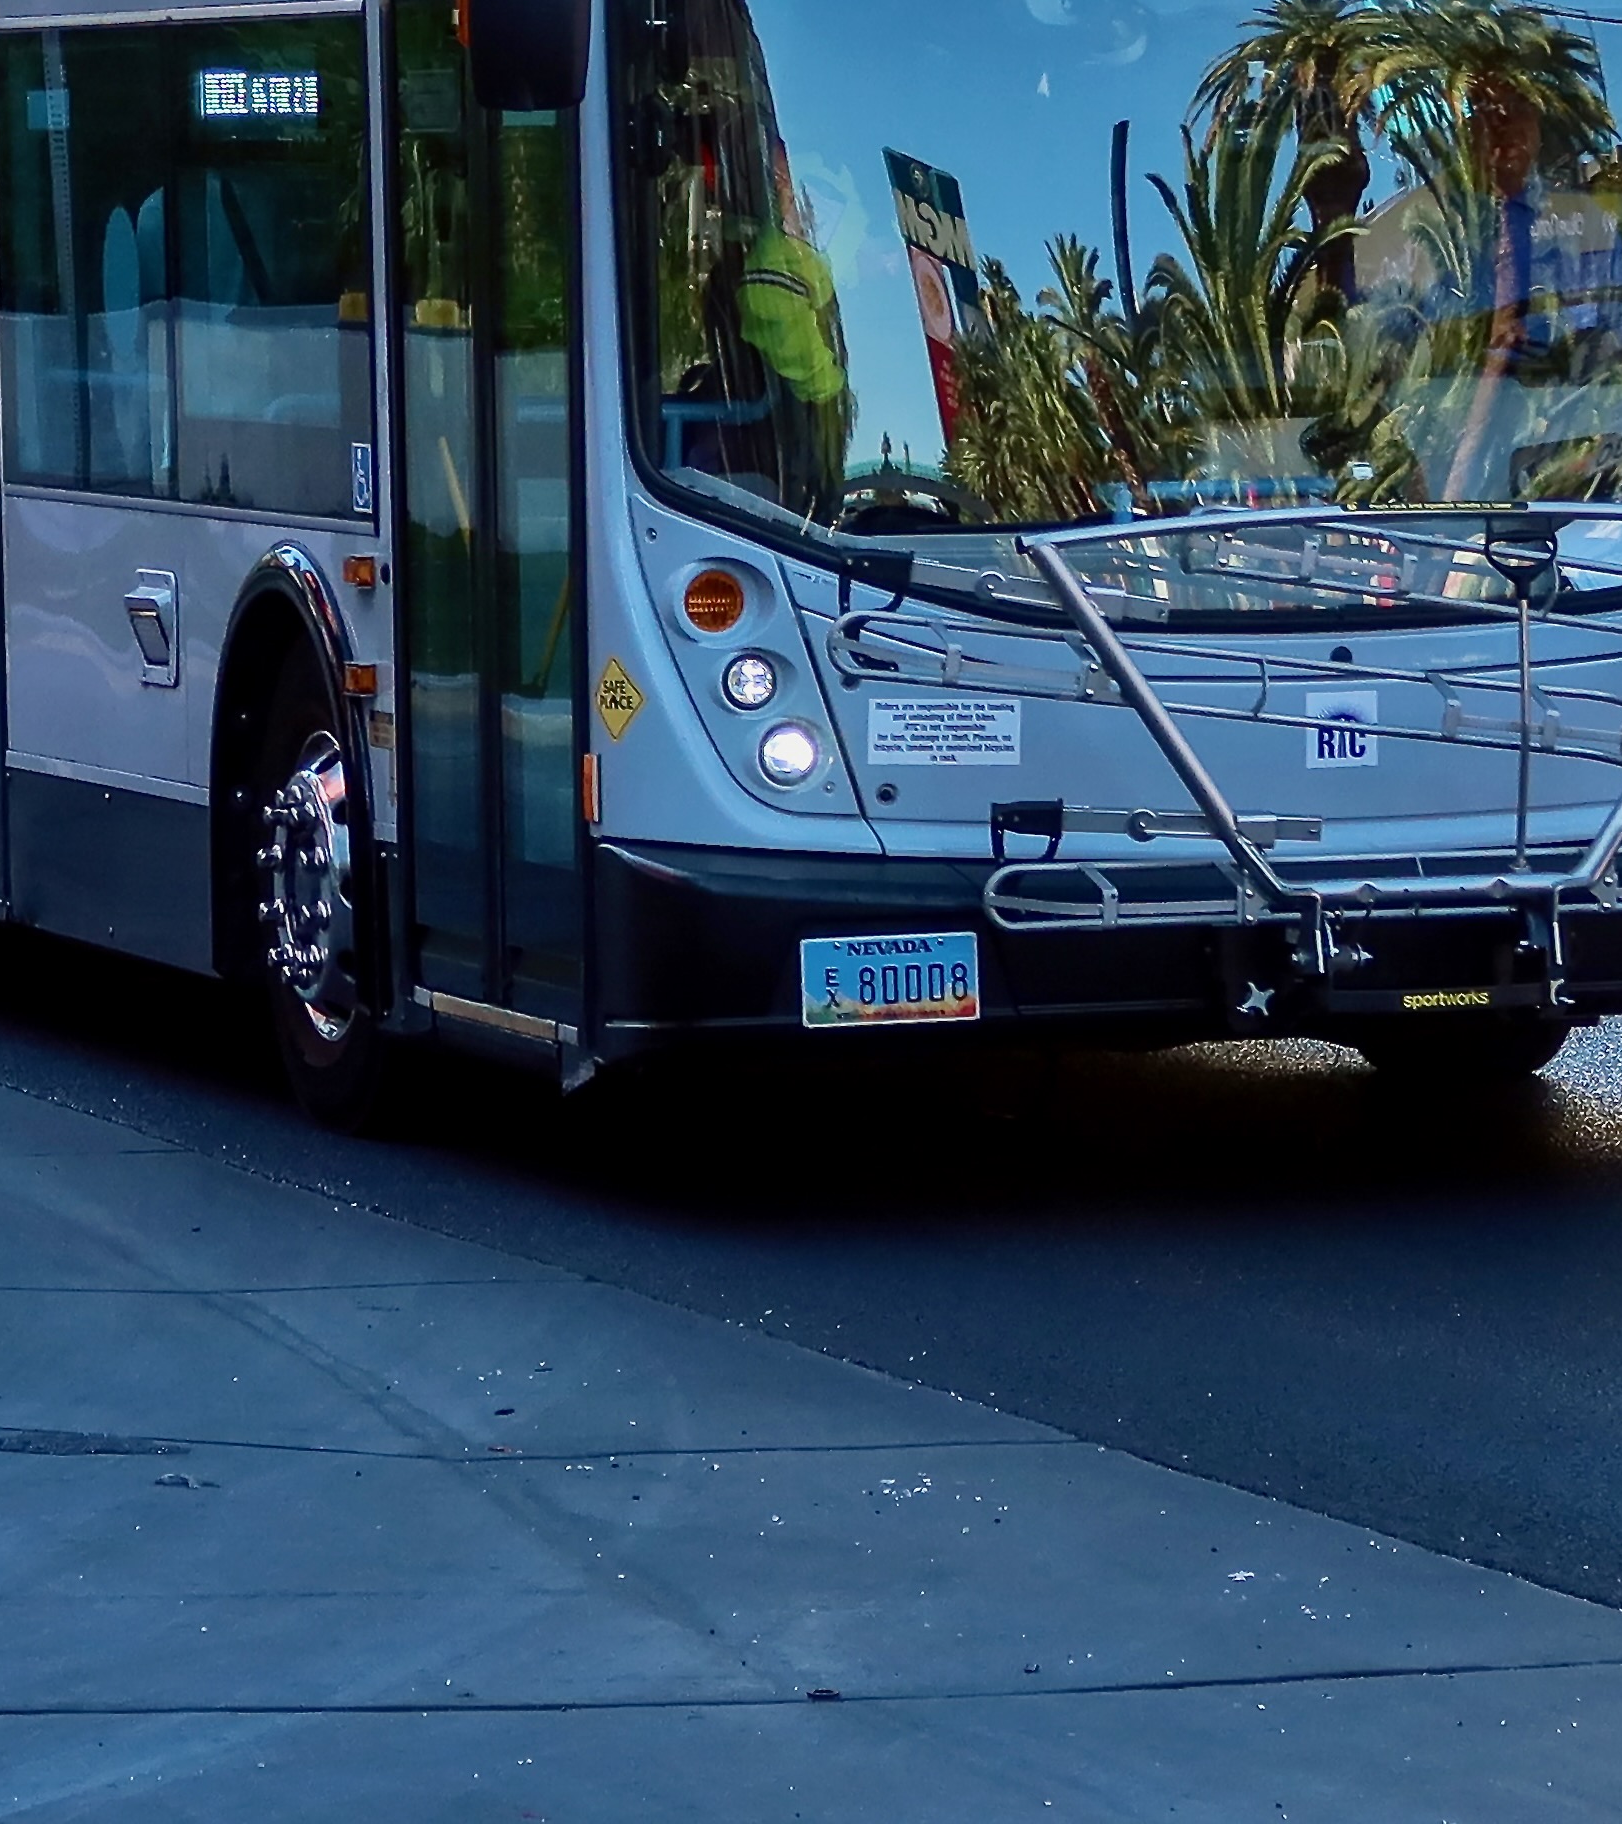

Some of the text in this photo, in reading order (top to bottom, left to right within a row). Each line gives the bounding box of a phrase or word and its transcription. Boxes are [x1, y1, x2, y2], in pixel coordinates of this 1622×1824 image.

[603, 679, 627, 695] SAFE
[599, 695, 634, 711] PLACE
[1317, 726, 1367, 759] RTC
[846, 938, 934, 956] NEVADA
[858, 961, 969, 1006] 80008
[1402, 989, 1491, 1010] sportworks
